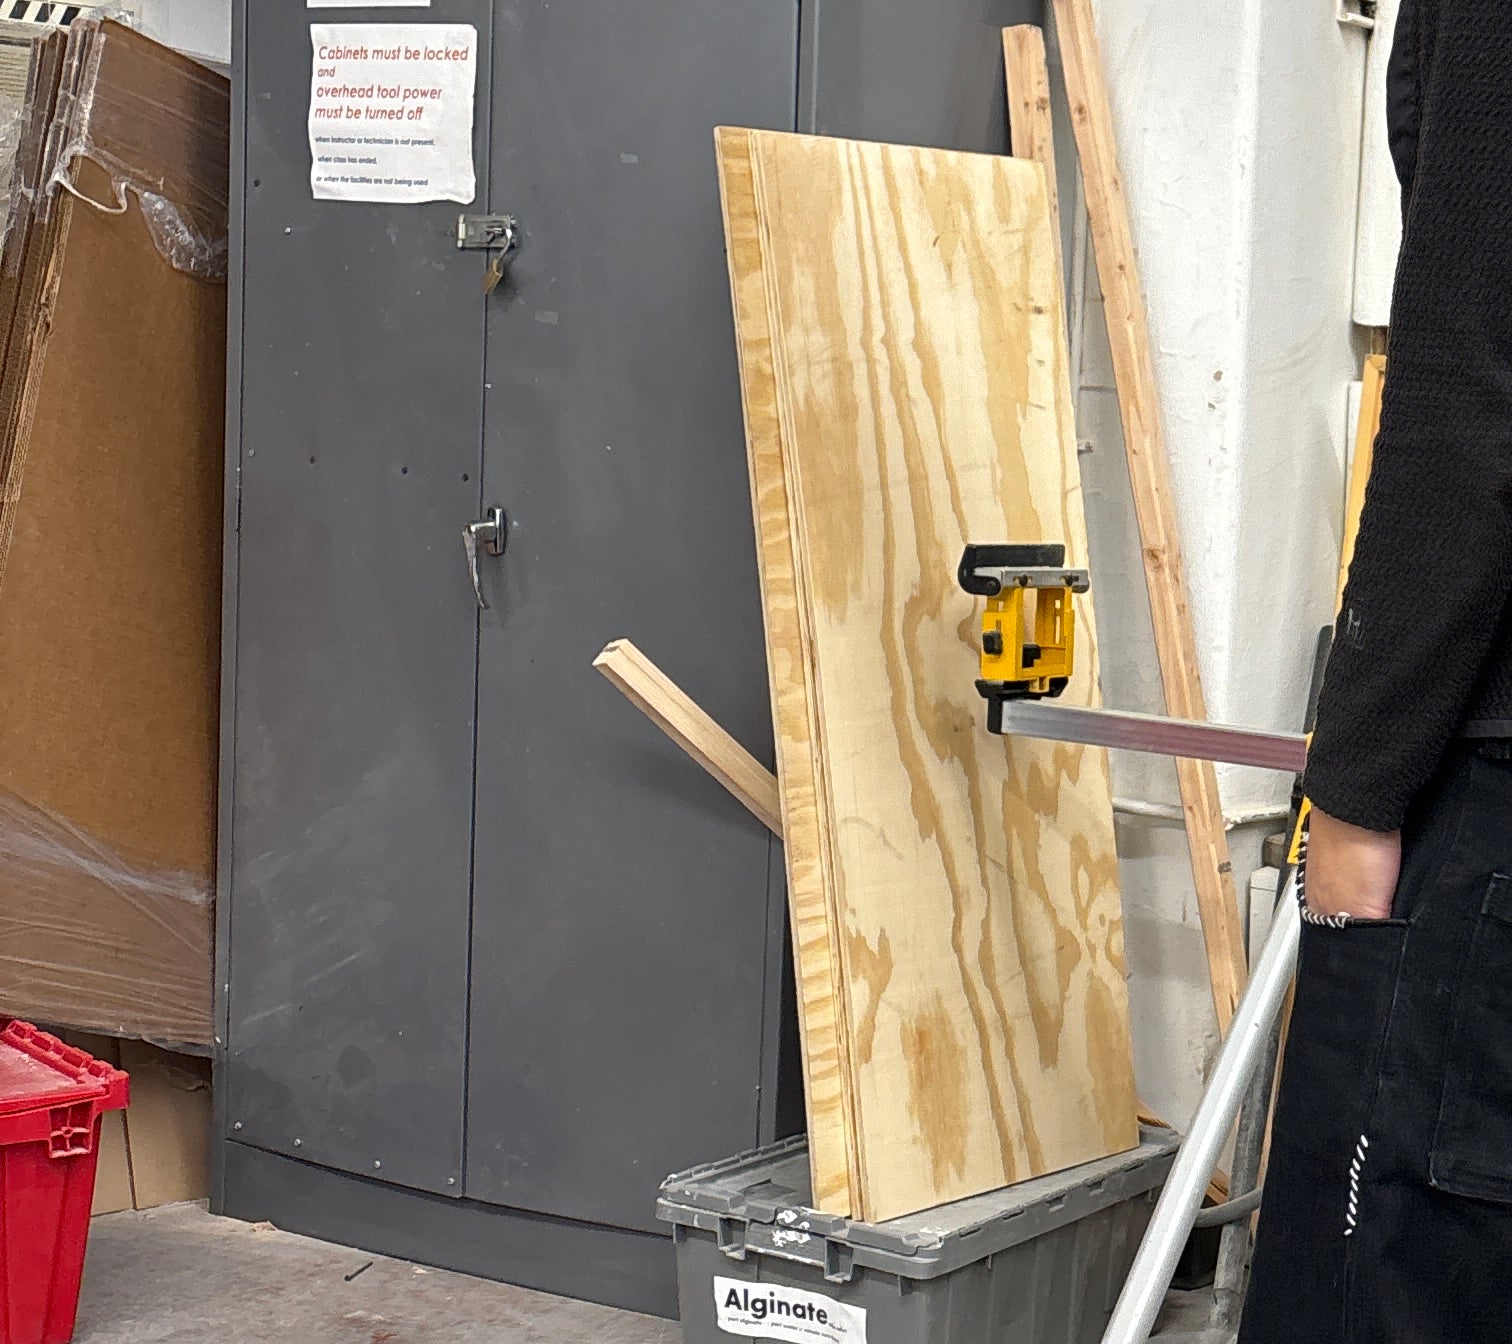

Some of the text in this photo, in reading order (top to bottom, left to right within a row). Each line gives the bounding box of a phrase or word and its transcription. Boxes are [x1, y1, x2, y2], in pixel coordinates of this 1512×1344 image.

[318, 46, 469, 61] Cabinets must be locked
[317, 66, 336, 78] and
[316, 84, 442, 102] overhead tool power
[314, 105, 424, 121] must be turned off
[724, 1287, 828, 1325] Alginate
